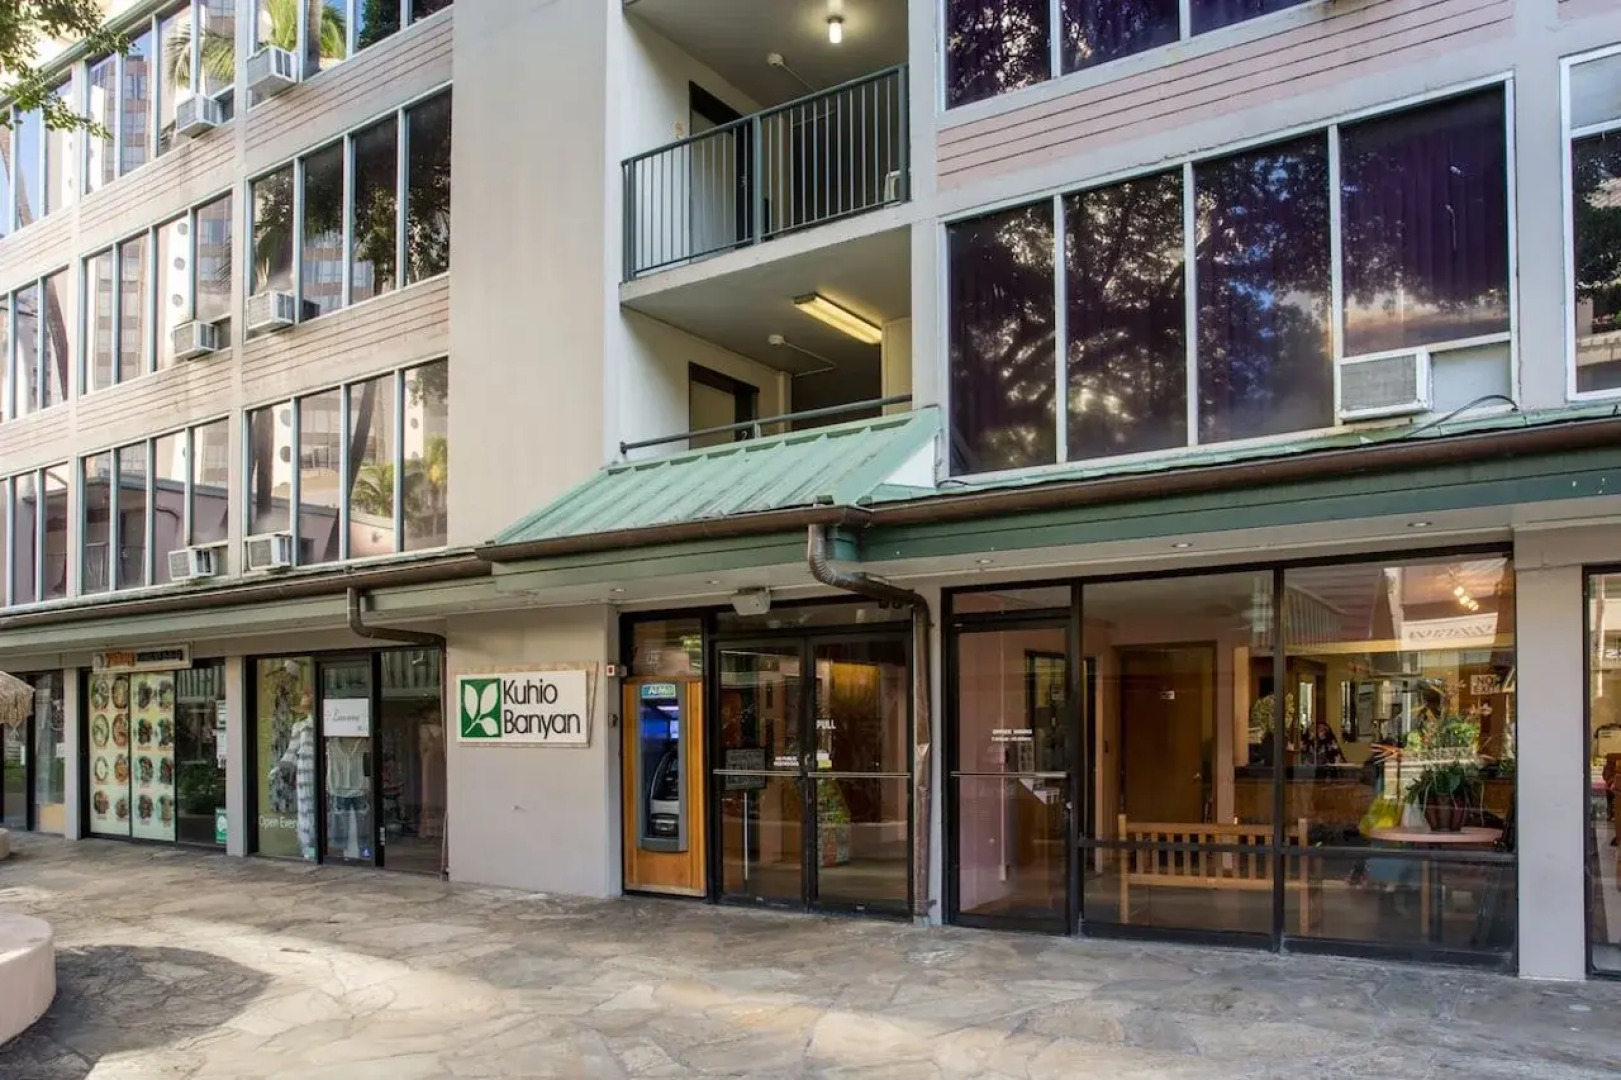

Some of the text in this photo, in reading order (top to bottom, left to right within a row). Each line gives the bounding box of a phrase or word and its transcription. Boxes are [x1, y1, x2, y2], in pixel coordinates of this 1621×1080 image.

[503, 678, 558, 705] Kuhio
[503, 709, 581, 739] Banyan
[816, 719, 836, 730] PULL
[259, 815, 278, 832] Open
